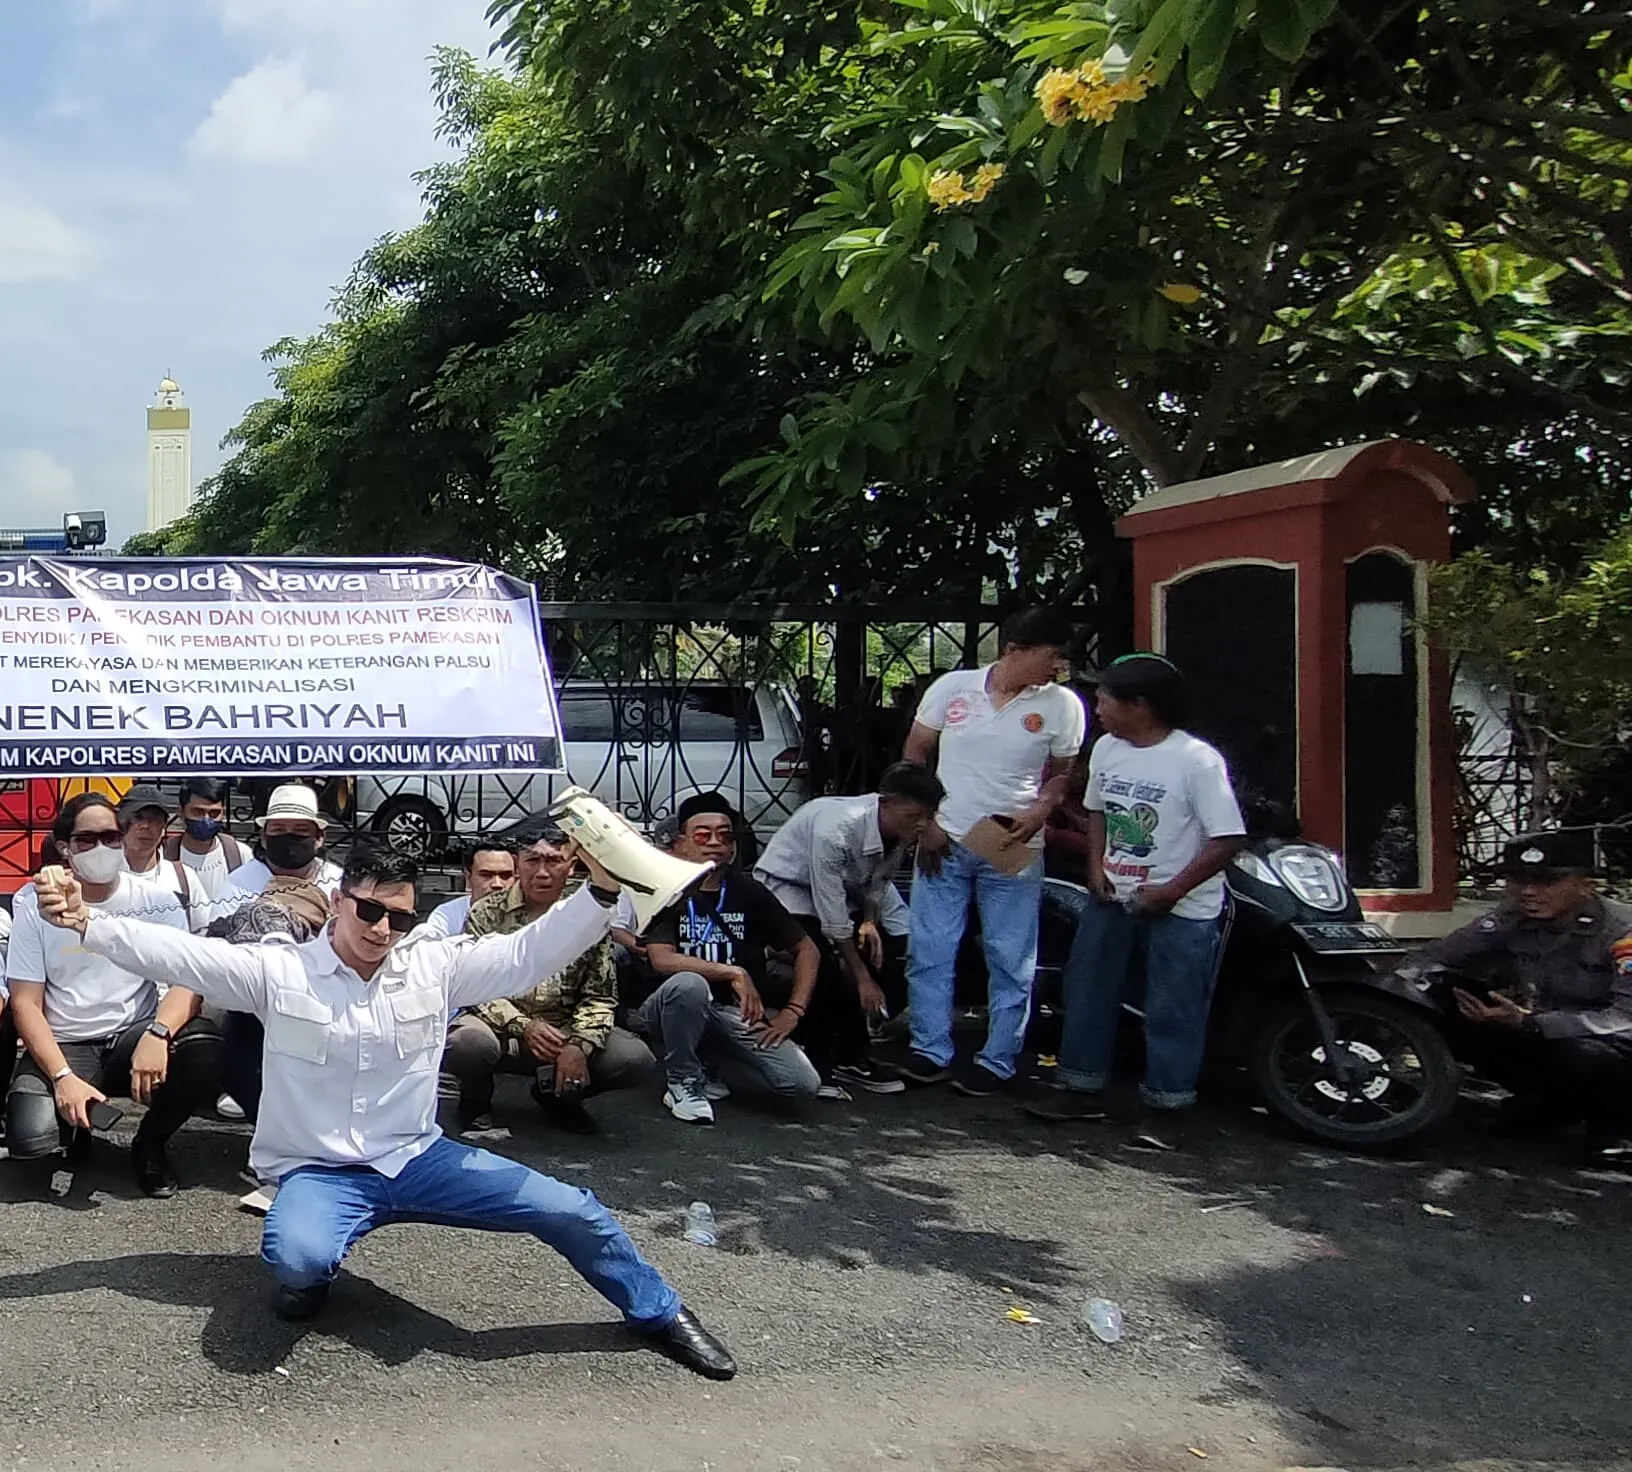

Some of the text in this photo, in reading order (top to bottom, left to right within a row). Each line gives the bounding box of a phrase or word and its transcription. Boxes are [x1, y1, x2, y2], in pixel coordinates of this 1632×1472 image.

[69, 565, 244, 594] Kapolda
[256, 568, 369, 593] Jawa
[379, 568, 497, 591] Timur
[209, 610, 254, 626] DAN
[261, 610, 341, 626] OKNUM
[347, 608, 410, 624] KANIT
[417, 606, 513, 624] RESKRIM
[80, 632, 86, 645] /
[91, 632, 176, 647] PENDIK
[181, 634, 281, 649] PEMBANTU
[287, 634, 305, 647] DI
[311, 633, 384, 647] POLRES
[389, 631, 500, 645] PAMEKASAN
[14, 656, 138, 670] MEREKAYASA
[142, 657, 179, 671] DAN
[184, 658, 303, 671] MEMBERIKAN
[307, 655, 430, 670] KETERANGAN
[433, 655, 491, 669] PALSU
[52, 677, 355, 694] DAN MENGKRIMINALISASI
[164, 703, 408, 730] BAHRIYAH
[25, 745, 147, 767] KAPOLRES
[153, 745, 293, 766] PAMEKASAN
[296, 745, 344, 764] DAN
[349, 744, 433, 763] OKNUM
[436, 744, 502, 763] KANIT
[506, 743, 536, 762] INI
